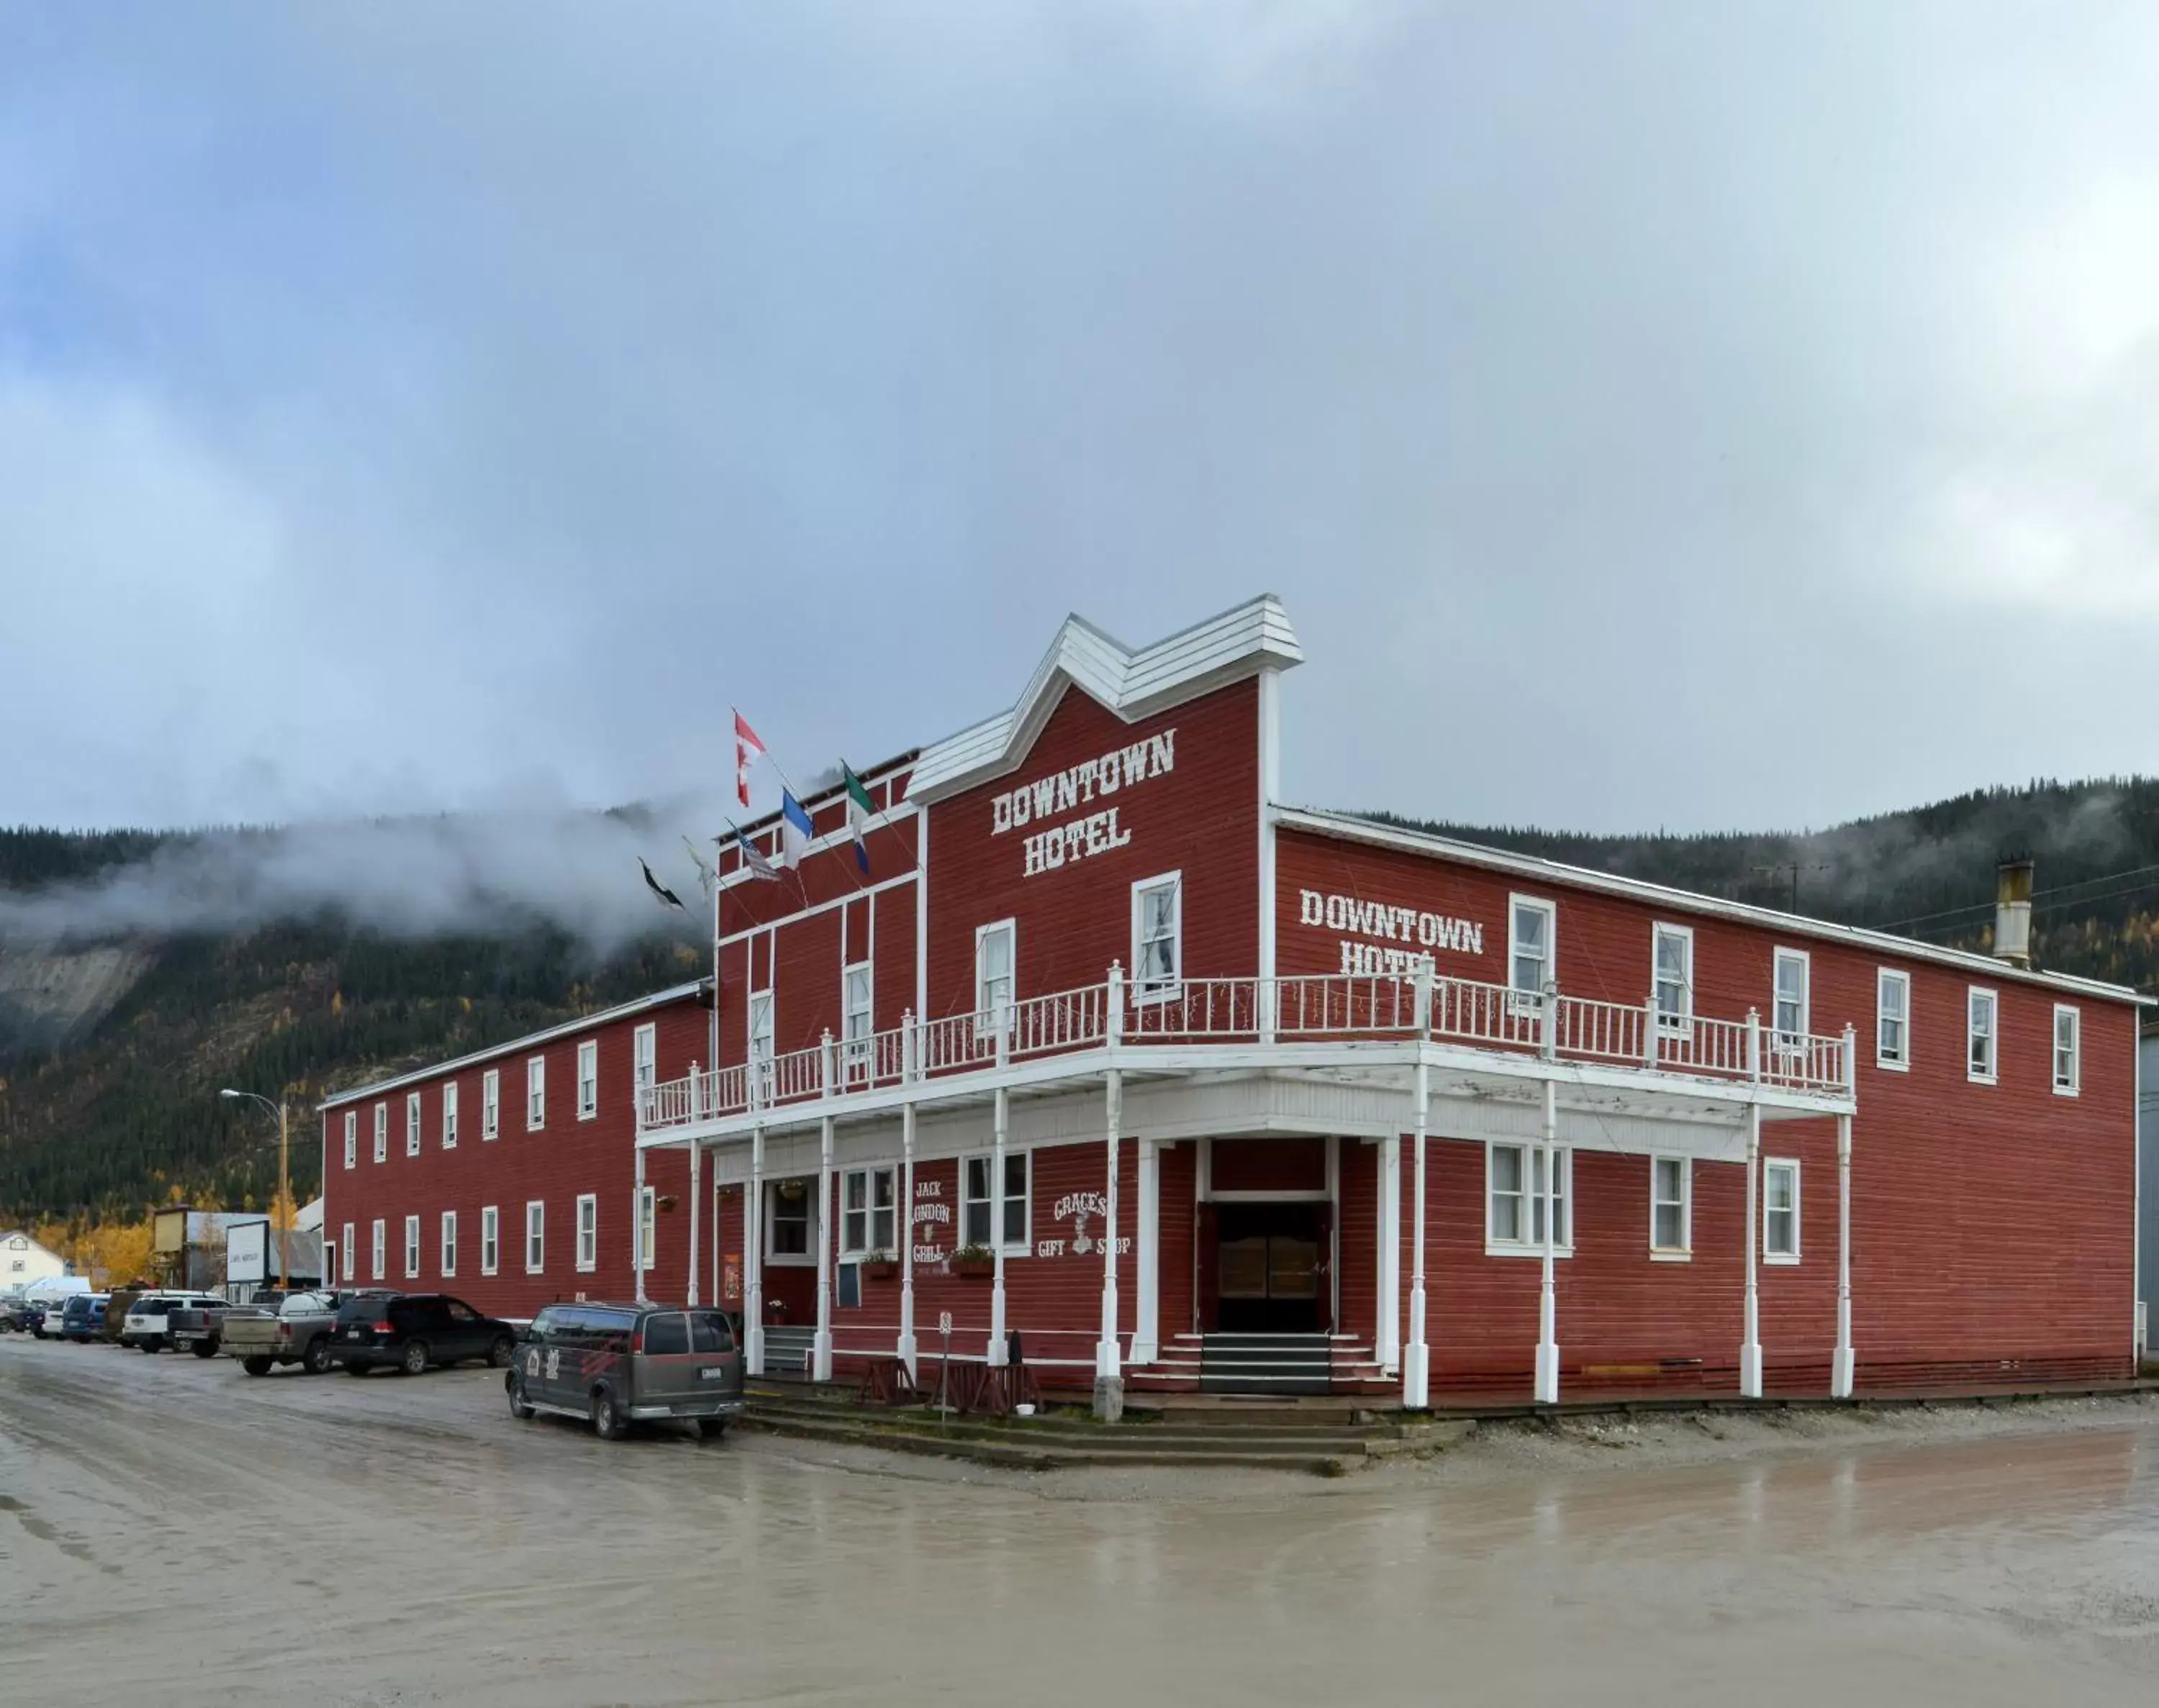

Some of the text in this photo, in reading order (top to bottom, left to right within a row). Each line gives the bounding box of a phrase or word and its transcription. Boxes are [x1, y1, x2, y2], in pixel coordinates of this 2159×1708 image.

[991, 728, 1178, 835] DOWNTOWN
[1023, 807, 1132, 877] HOTEL
[1299, 889, 1484, 955] DOWNTOWN
[916, 1181, 941, 1197] JACK
[910, 1204, 950, 1225] ONDON
[913, 1244, 944, 1263] GRILL
[1038, 1237, 1131, 1258] GIFT SOP
